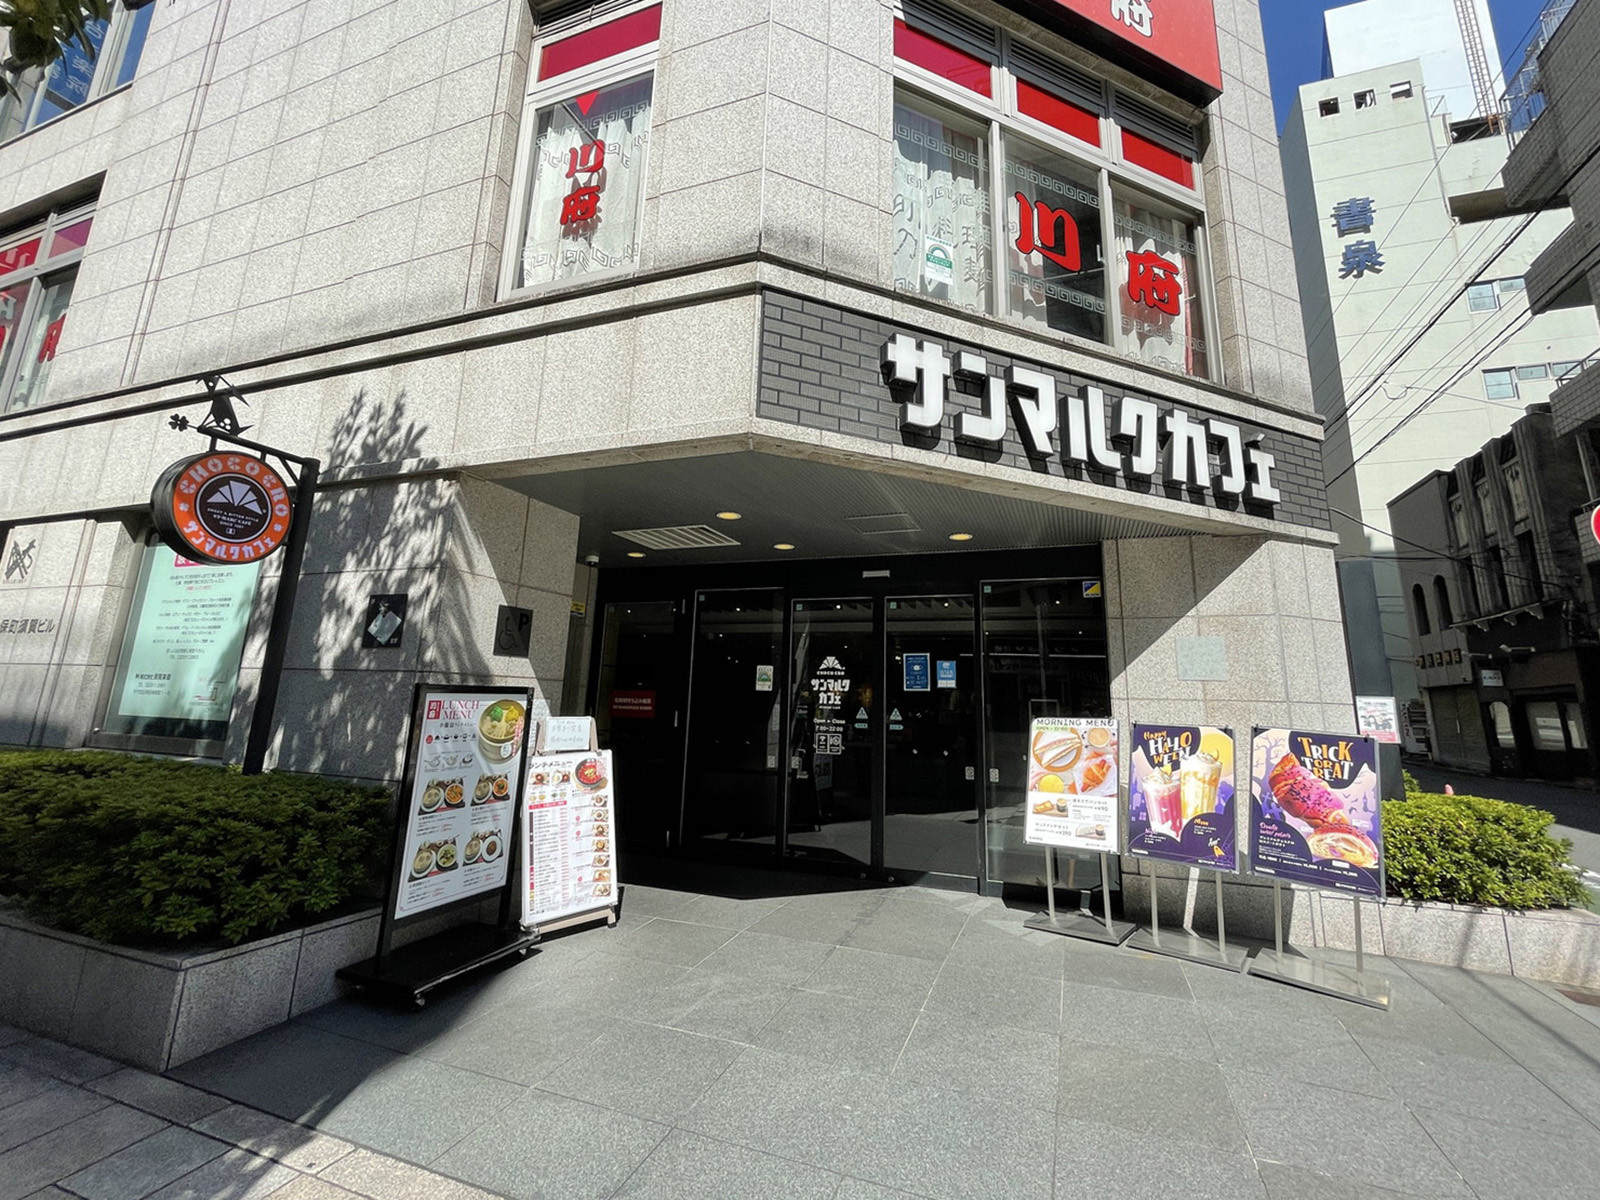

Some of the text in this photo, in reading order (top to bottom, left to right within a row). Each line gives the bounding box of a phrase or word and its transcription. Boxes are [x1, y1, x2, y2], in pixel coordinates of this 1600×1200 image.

[1331, 197, 1386, 275] 書泉
[885, 333, 1281, 507] サンマルクカフェ
[180, 456, 289, 517] CHOCO CRO
[183, 520, 276, 560] サンマルクカフェ
[811, 678, 851, 692] サンマルク
[441, 700, 480, 710] LUNCH
[818, 691, 842, 705] カフェ
[443, 710, 476, 720] MENU
[1036, 718, 1115, 728] MORNING MENU
[1143, 730, 1167, 741] Happy
[1149, 731, 1192, 756] HALLO
[1297, 736, 1354, 762] TRICK
[1313, 759, 1333, 769] OR
